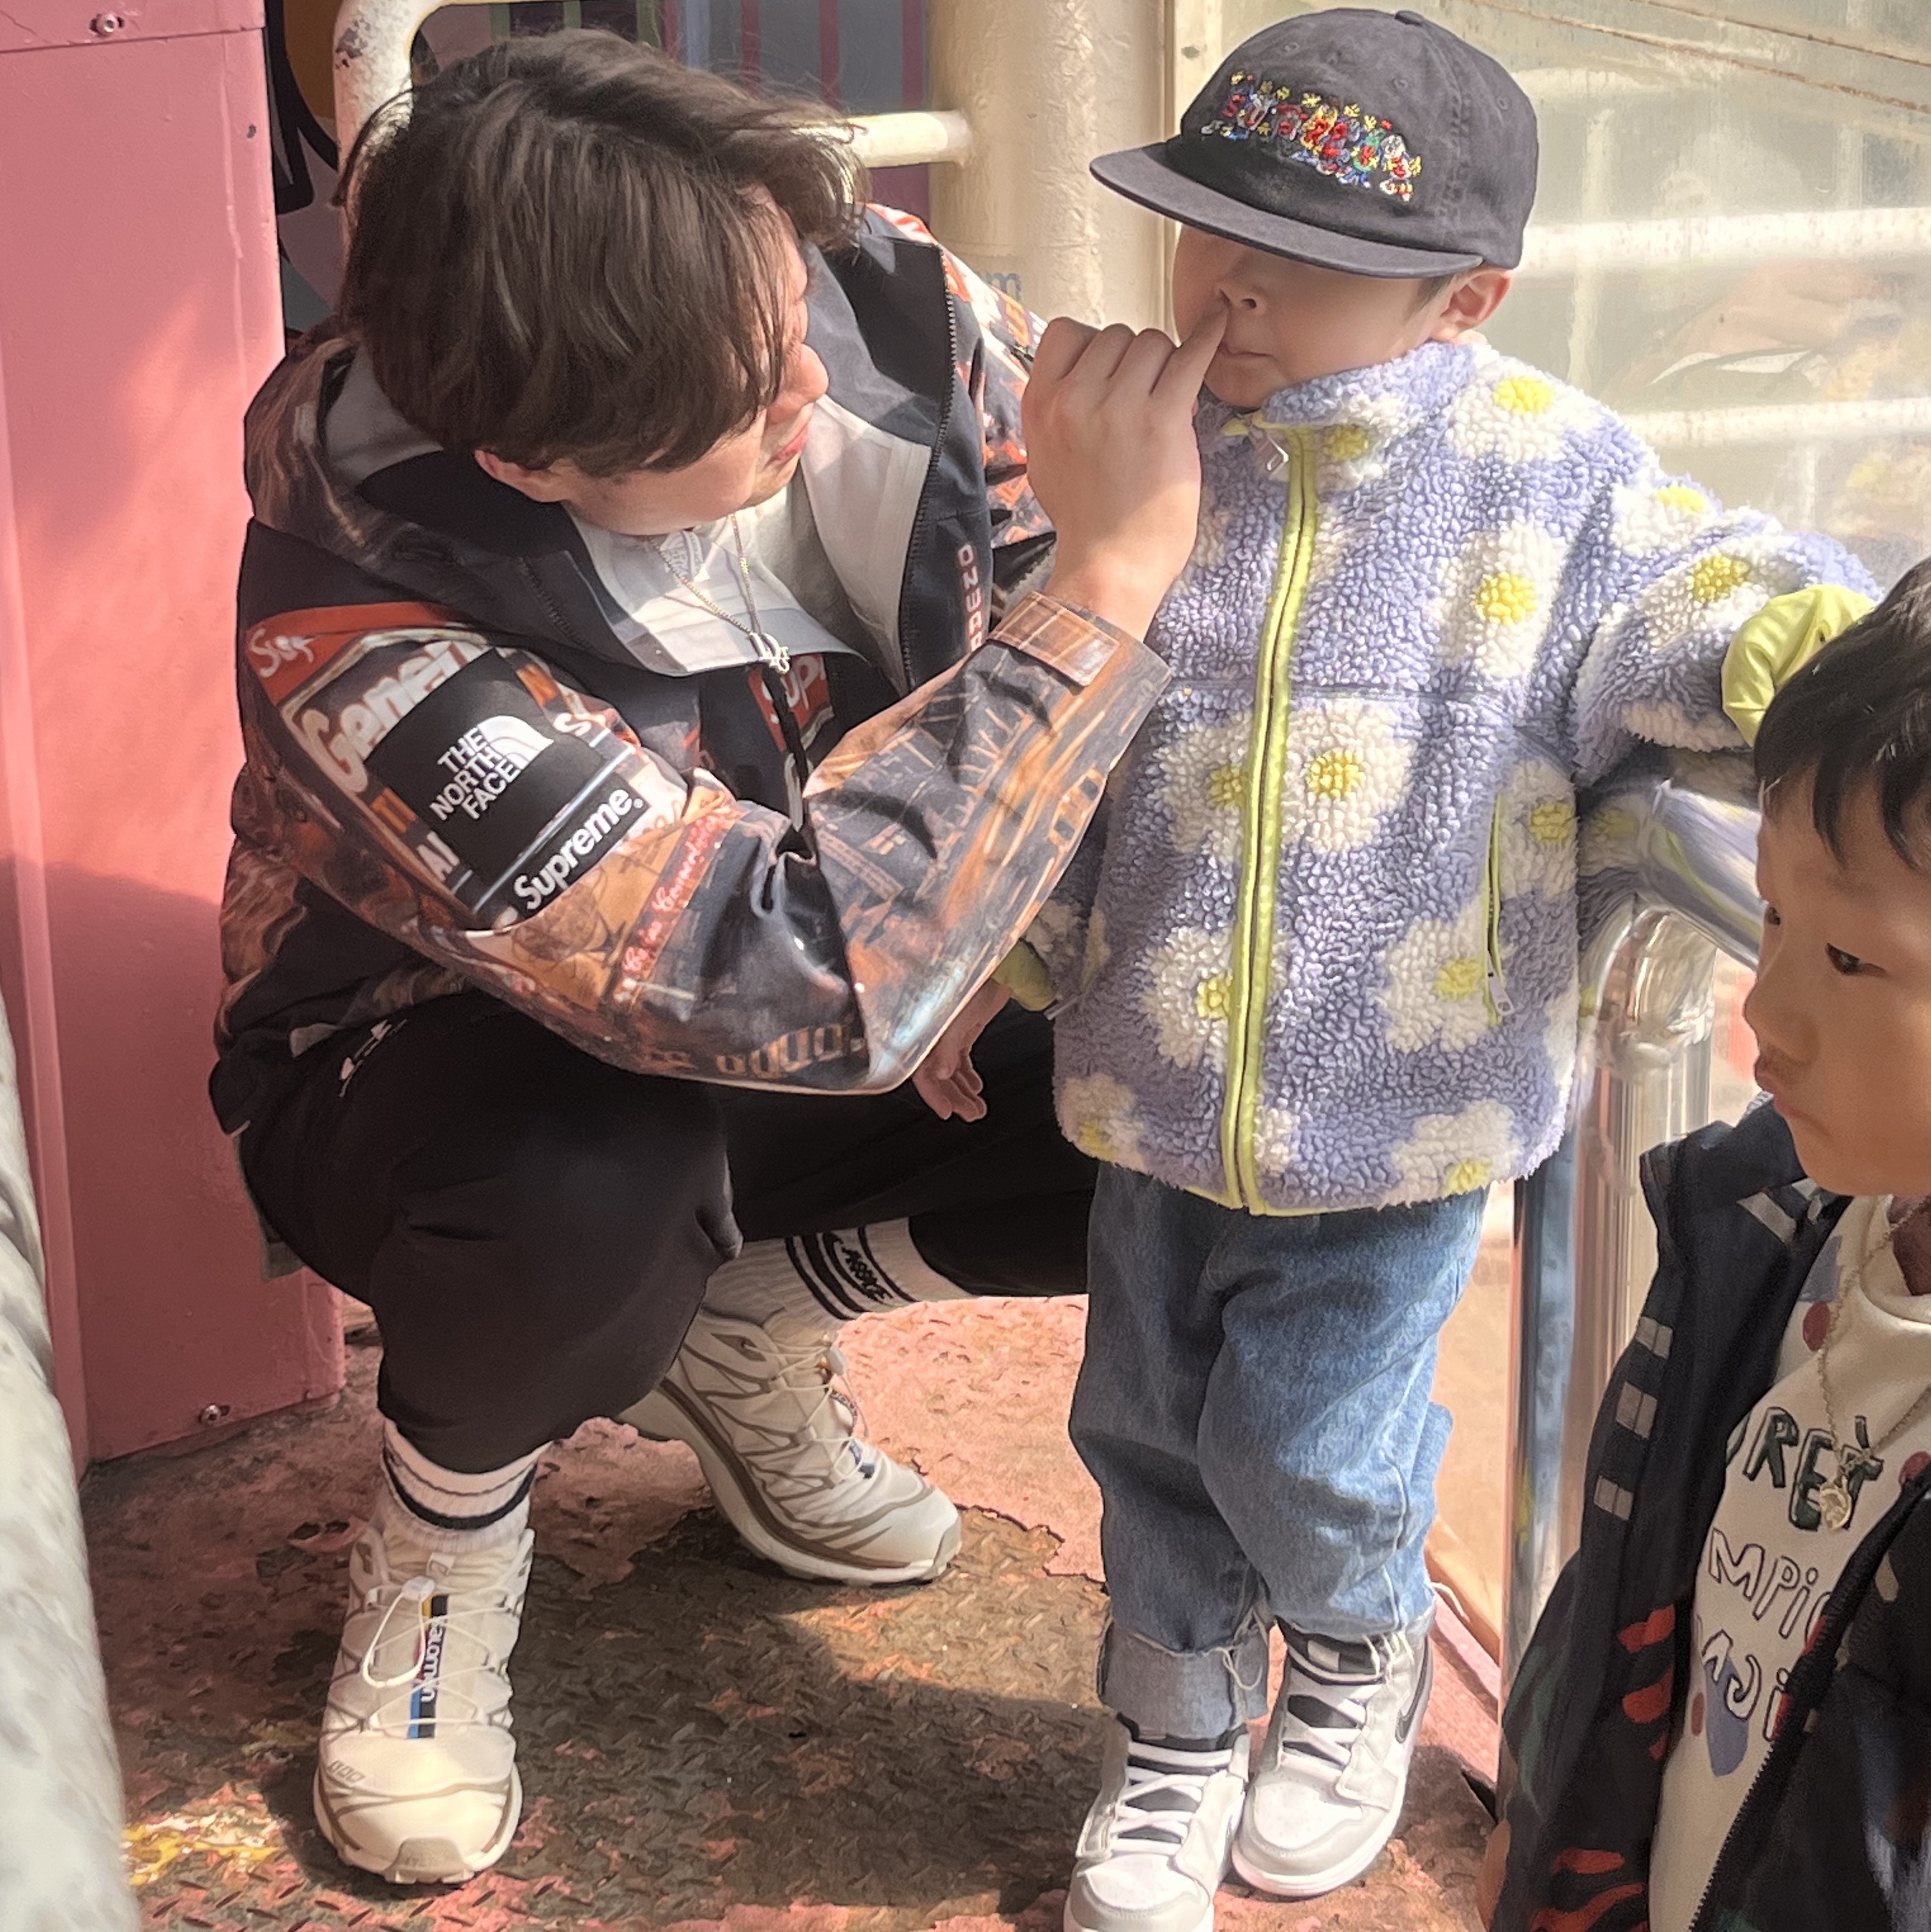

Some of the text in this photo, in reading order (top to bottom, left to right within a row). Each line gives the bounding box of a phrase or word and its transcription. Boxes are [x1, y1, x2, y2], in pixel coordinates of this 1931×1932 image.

[430, 746, 502, 821] NORTH
[437, 726, 487, 773] THE
[461, 759, 521, 820] FACE
[514, 788, 633, 910] Supreme
[421, 1615, 445, 1703] alomn
